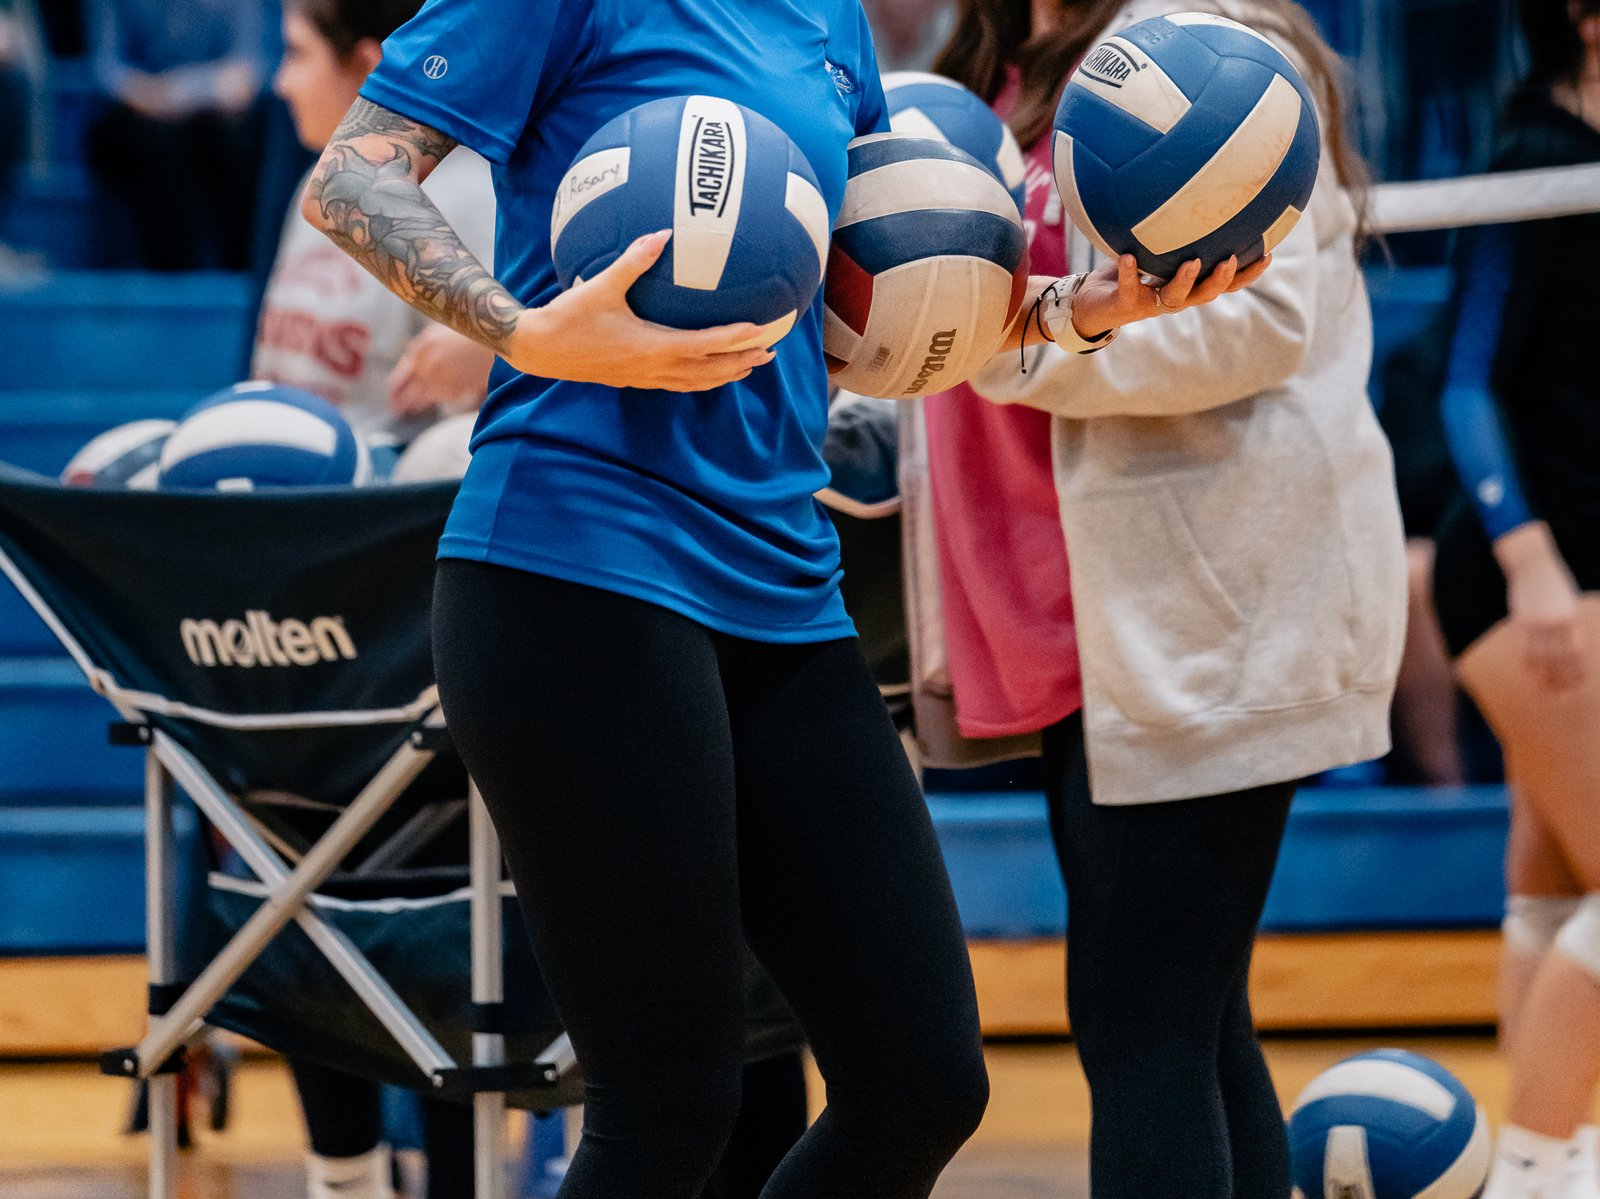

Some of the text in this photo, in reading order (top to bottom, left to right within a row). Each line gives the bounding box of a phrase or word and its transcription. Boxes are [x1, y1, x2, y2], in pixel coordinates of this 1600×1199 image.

[1084, 47, 1131, 81] CHIKARA
[569, 163, 620, 200] Rosary
[691, 121, 727, 215] TACHIKARA
[902, 329, 957, 396] Wilson
[180, 610, 357, 668] molten
